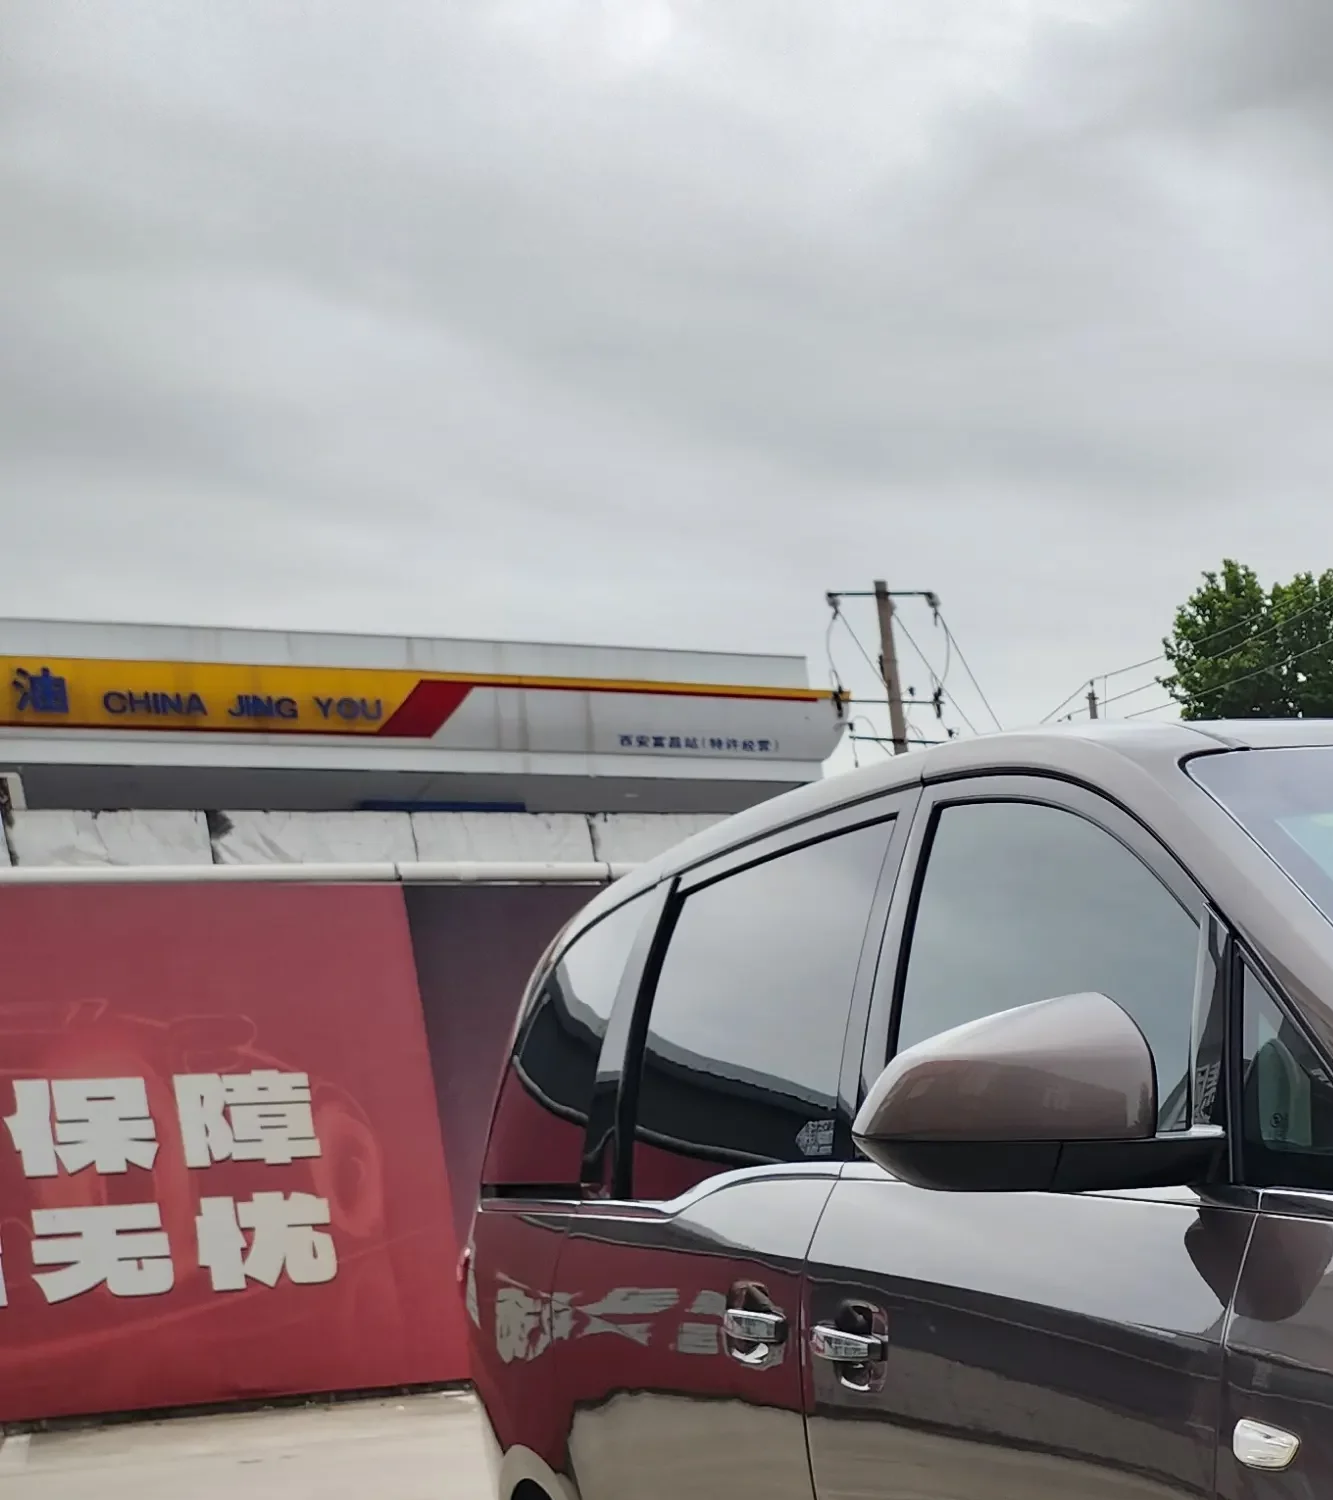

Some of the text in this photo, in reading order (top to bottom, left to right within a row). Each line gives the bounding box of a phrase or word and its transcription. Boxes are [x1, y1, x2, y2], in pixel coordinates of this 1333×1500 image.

[11, 666, 383, 721] 油 CHINA JING YOU
[3, 1069, 322, 1179] 保障
[0, 1191, 338, 1308] 无忧
